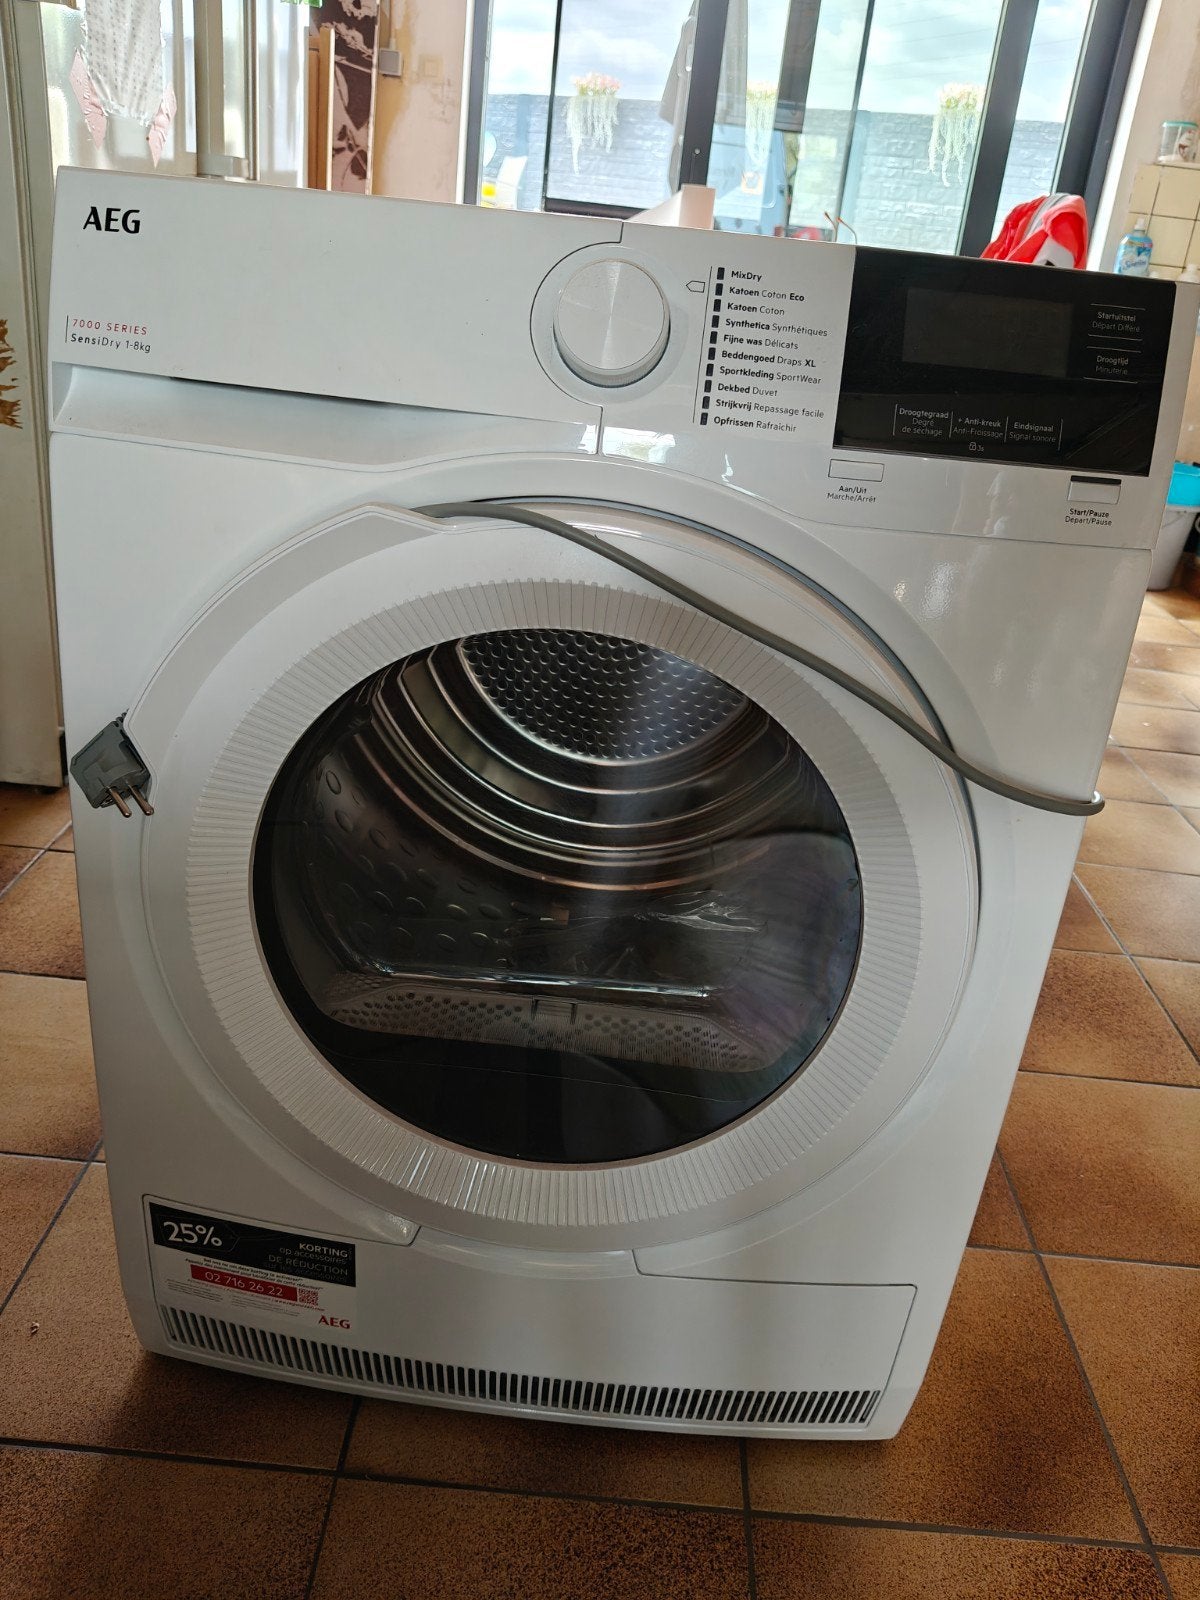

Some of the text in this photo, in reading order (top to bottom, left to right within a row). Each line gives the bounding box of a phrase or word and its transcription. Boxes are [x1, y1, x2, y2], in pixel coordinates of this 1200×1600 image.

[83, 206, 141, 234] AEG
[731, 270, 762, 282] MixDry
[729, 286, 805, 301] Katoen Coton Eco
[727, 302, 785, 316] Katoen Coton
[72, 318, 148, 336] 7000 SERIES
[725, 318, 828, 337] Synthetica Synthétiques
[70, 333, 151, 354] SensiDry 1-8kg
[723, 334, 799, 350] Fijne was Délicats
[721, 350, 816, 368] Beddengoed Draps XL
[719, 366, 822, 385] Sportkleding SportWear
[717, 383, 778, 397] Dekbed Duvet
[715, 398, 825, 419] Strijkvrij Repassage facile
[899, 407, 949, 419] Droogtegraad
[713, 416, 754, 428] Opfrissen
[901, 425, 912, 433] de
[964, 417, 1001, 428] Anti-kreuk
[1013, 421, 1054, 433] Eindsignaal
[952, 426, 1003, 438] Anti-Froissage
[838, 485, 867, 494] Aan/Uit
[1069, 508, 1110, 518] Start/Pauze
[163, 1221, 223, 1247] 25%
[299, 1242, 348, 1258] KORTING
[268, 1254, 285, 1265] DE
[287, 1255, 348, 1276] RÉDUCTION
[205, 1271, 284, 1297] 02 716 26 22
[318, 1315, 351, 1330] AEG
